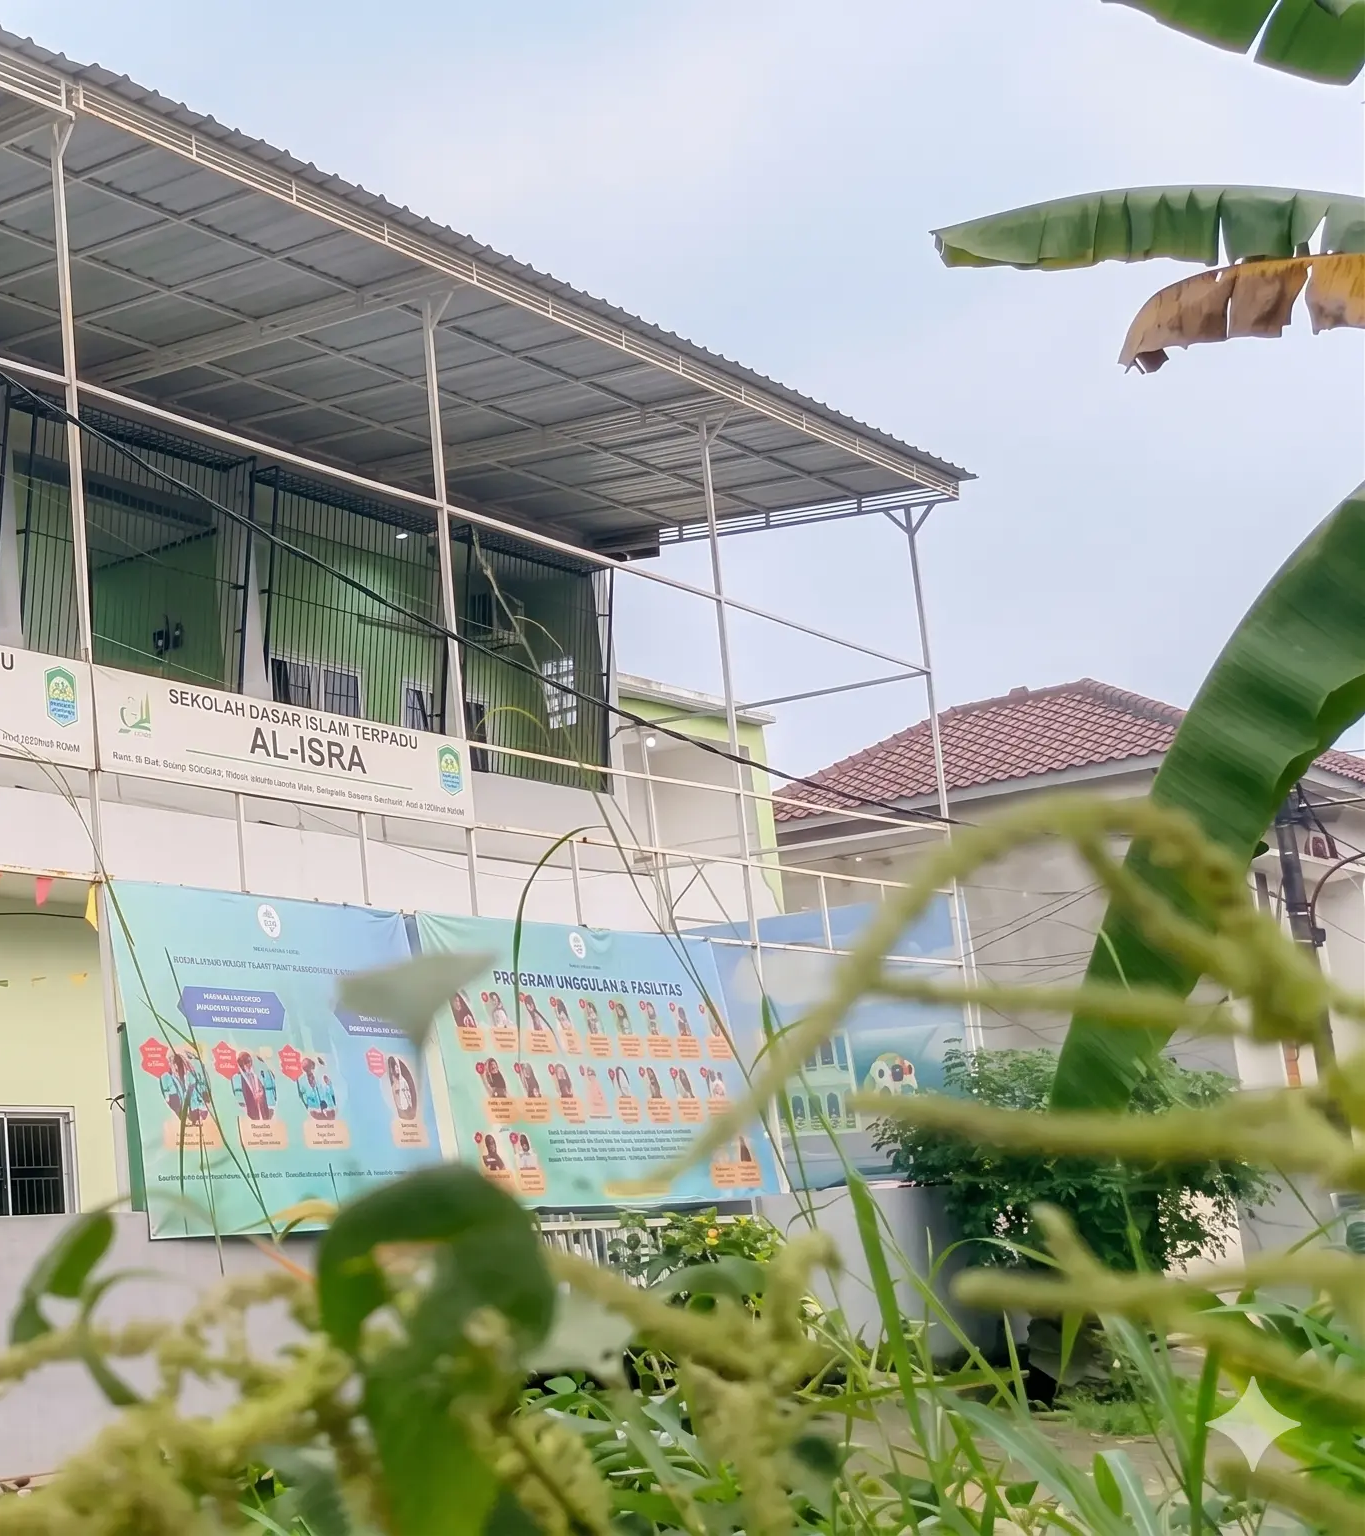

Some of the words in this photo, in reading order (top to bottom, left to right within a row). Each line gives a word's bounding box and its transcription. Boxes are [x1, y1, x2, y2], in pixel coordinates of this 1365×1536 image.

[168, 689, 245, 717] SEKOLAH
[249, 704, 302, 728] DASAR
[306, 715, 349, 738] ISLAM
[353, 724, 418, 750] TERPADU
[249, 726, 367, 774] AL-ISRA
[493, 970, 555, 988] PROGRAM
[555, 975, 618, 993] UNGGULAN
[620, 980, 629, 994] &
[631, 980, 683, 997] FASILITAS
